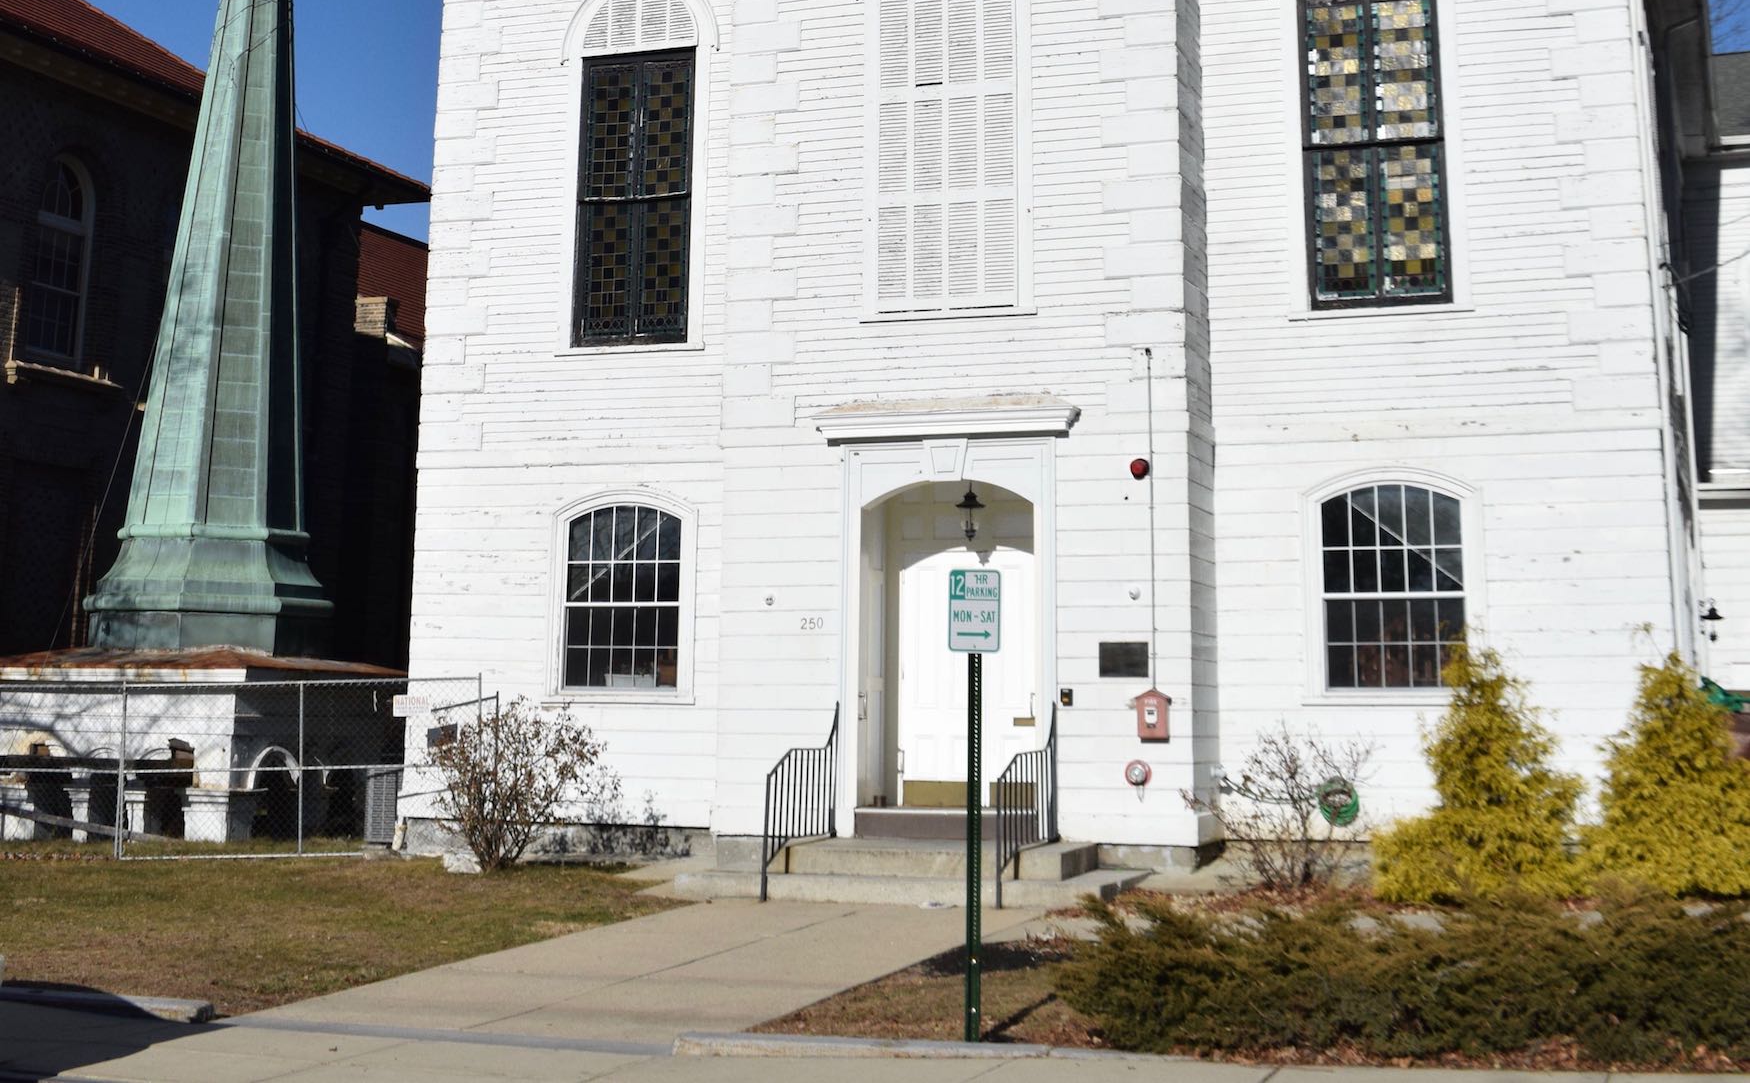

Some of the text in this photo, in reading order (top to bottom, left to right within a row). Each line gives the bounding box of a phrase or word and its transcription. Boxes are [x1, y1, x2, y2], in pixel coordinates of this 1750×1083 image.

[951, 575, 988, 595] 12 HR
[966, 587, 998, 598] PARKING
[800, 617, 824, 630] 250
[395, 696, 430, 706] NATIONAL
